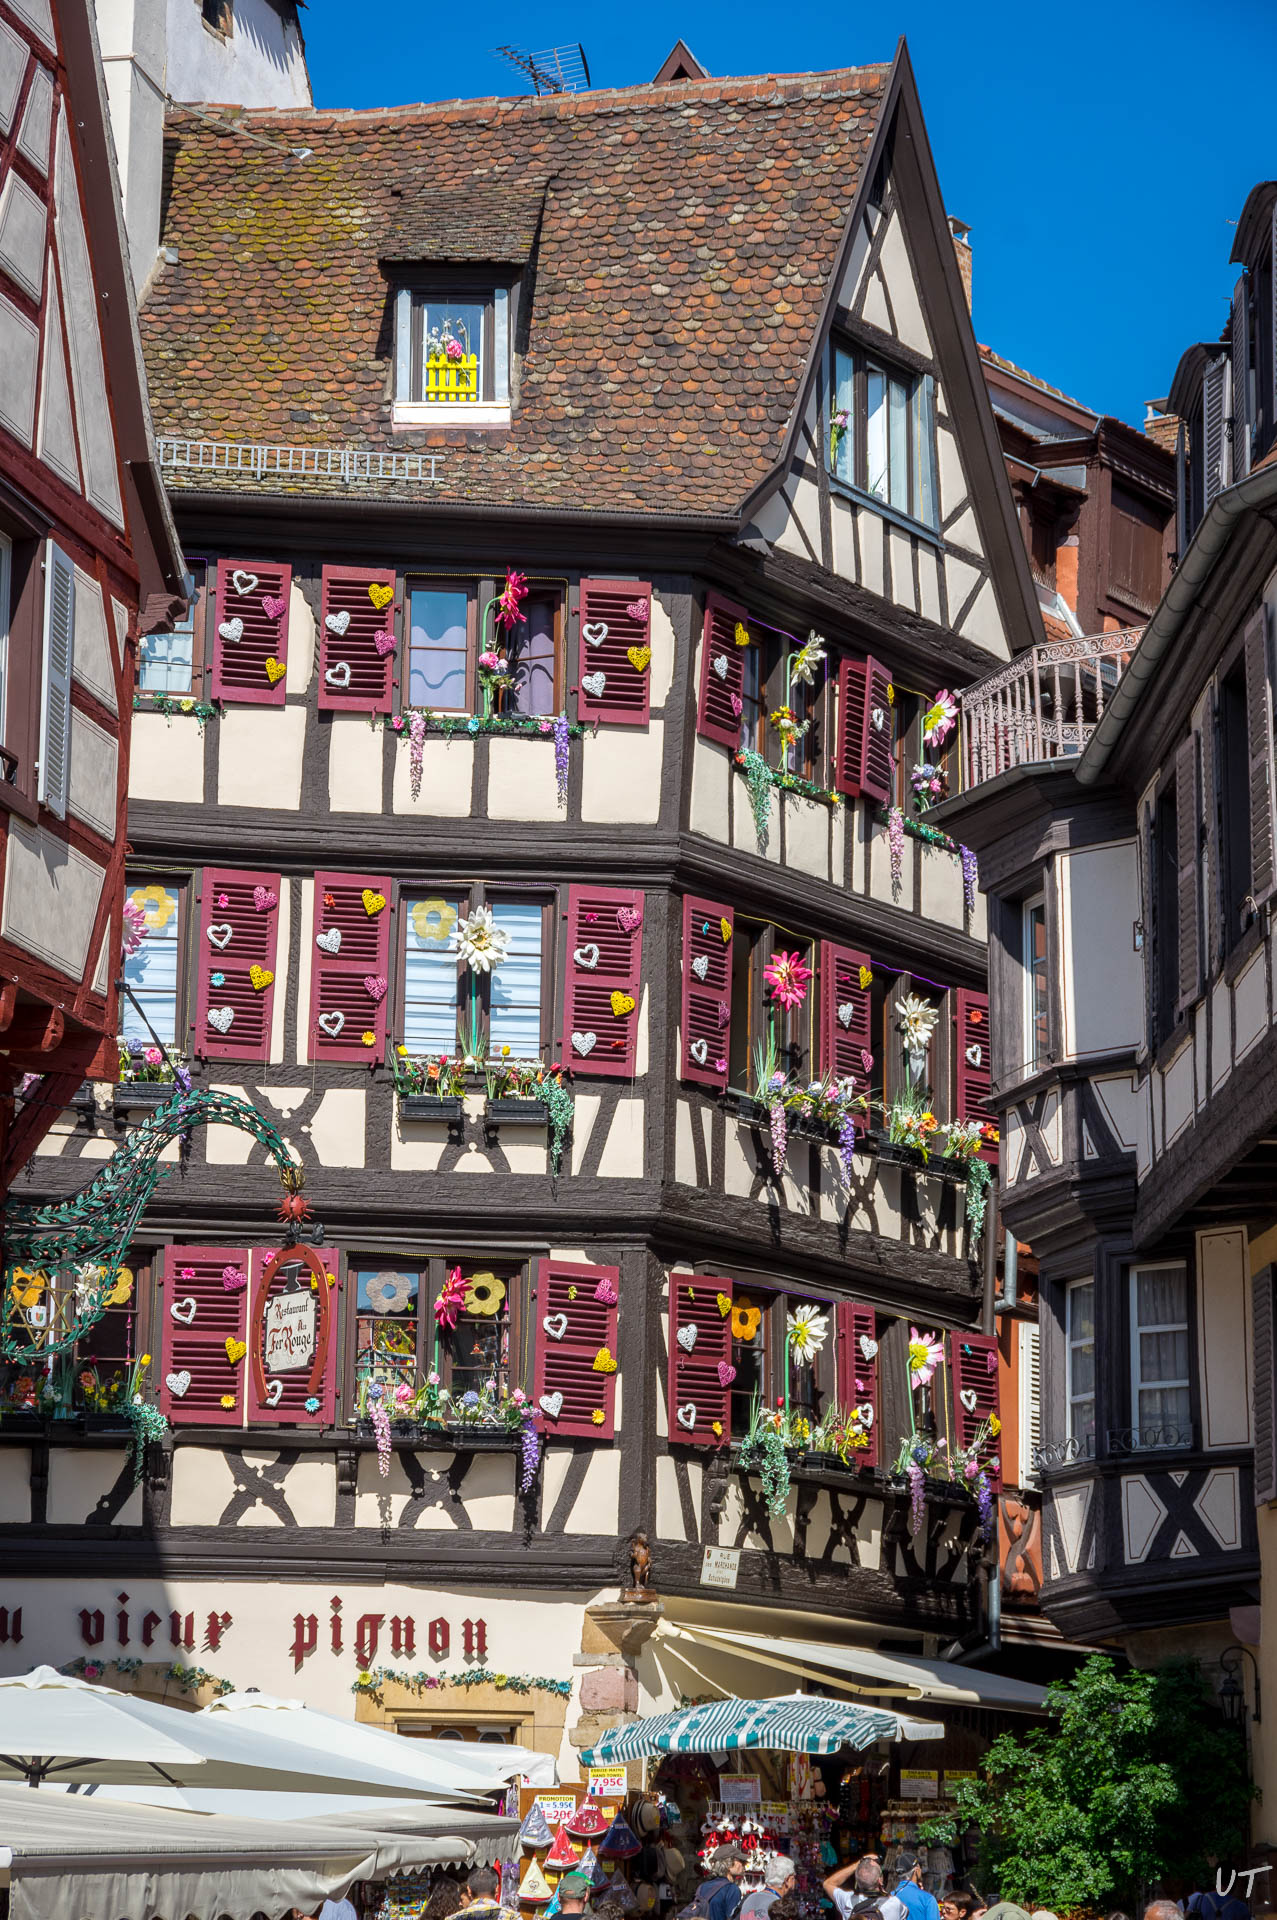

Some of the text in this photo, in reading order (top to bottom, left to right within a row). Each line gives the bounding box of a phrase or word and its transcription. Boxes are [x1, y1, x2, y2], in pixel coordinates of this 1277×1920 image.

[275, 1297, 309, 1320] Restaurant
[298, 1320, 307, 1331] Au
[268, 1325, 311, 1360] Fer Rouge
[78, 1592, 233, 1648] vieux
[289, 1595, 489, 1673] pignon
